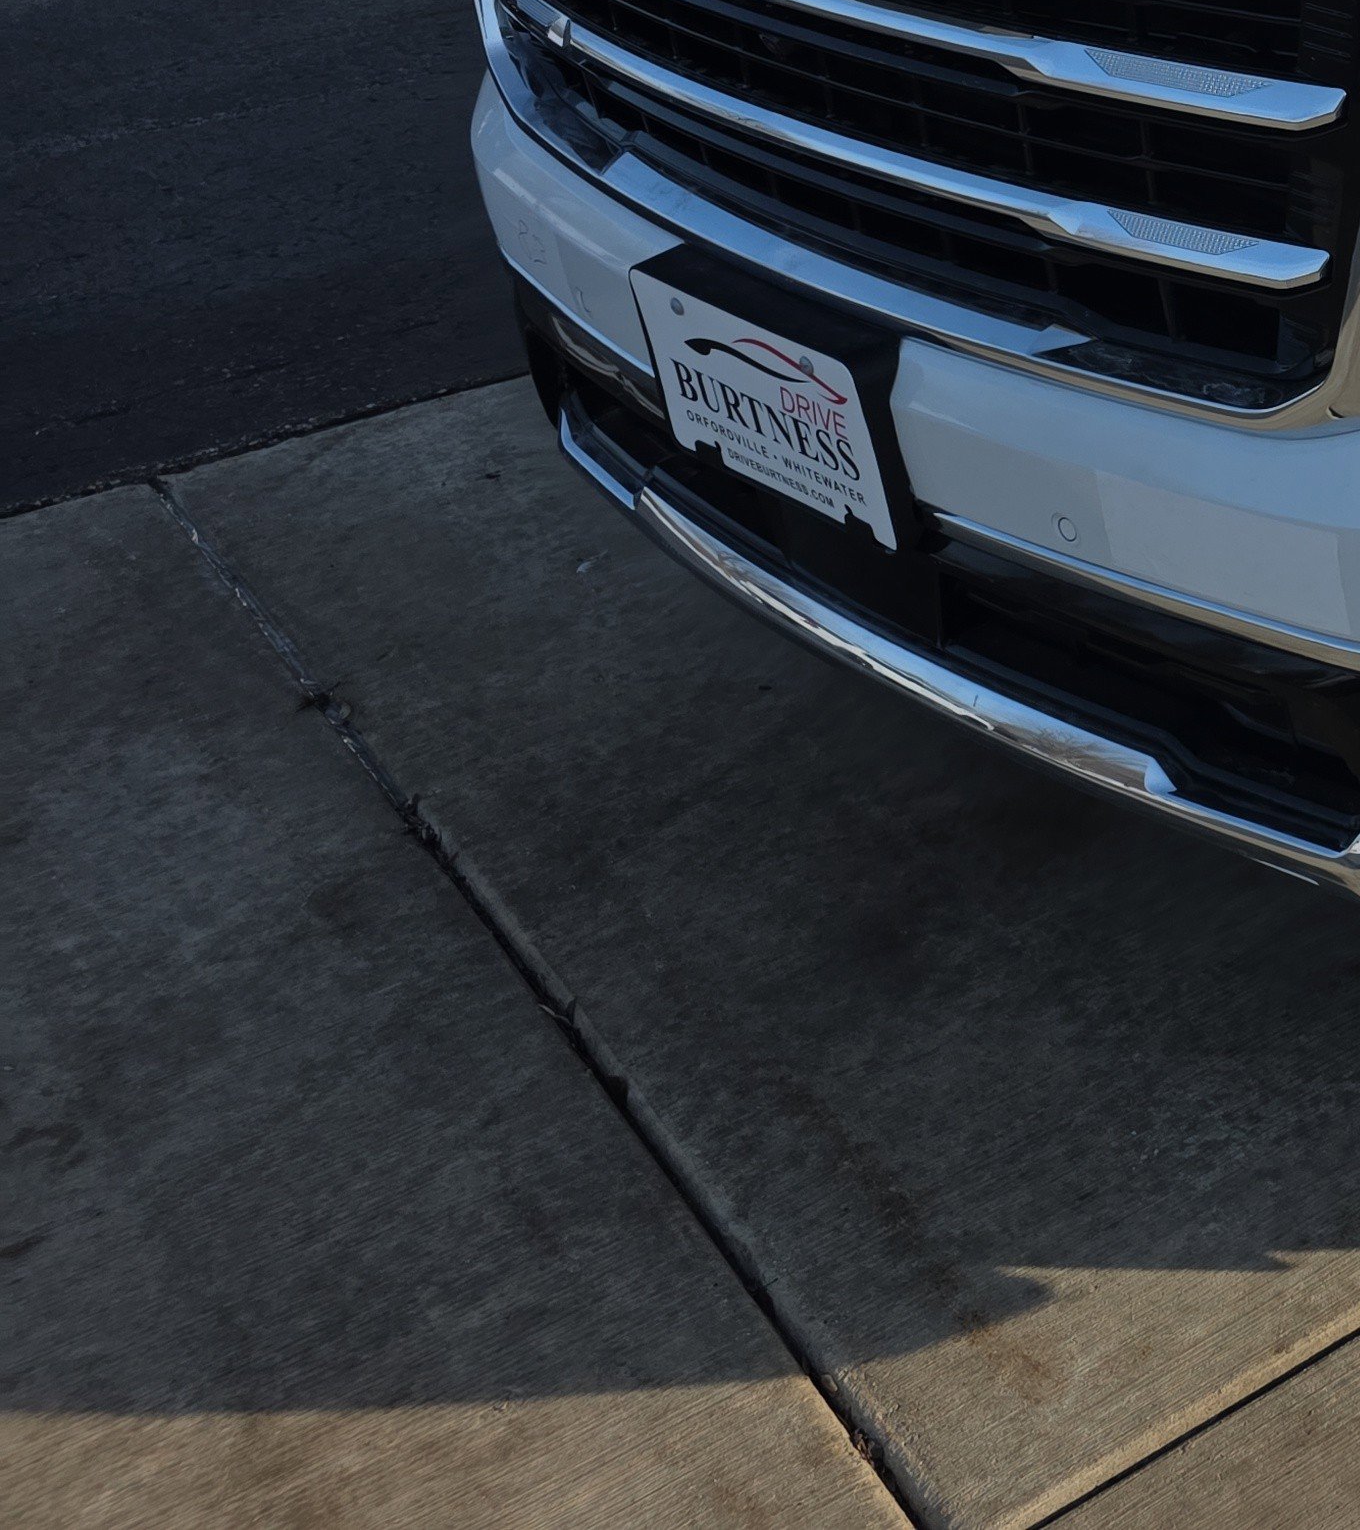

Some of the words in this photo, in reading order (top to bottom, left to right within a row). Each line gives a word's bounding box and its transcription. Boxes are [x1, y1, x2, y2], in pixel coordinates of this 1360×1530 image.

[669, 357, 860, 481] BURTNESS
[780, 386, 848, 441] DRIVE
[686, 409, 768, 459] ORFORDVILLE
[782, 456, 867, 507] WHITEWATER
[727, 448, 835, 509] DRIVEBURTNESS.COM
